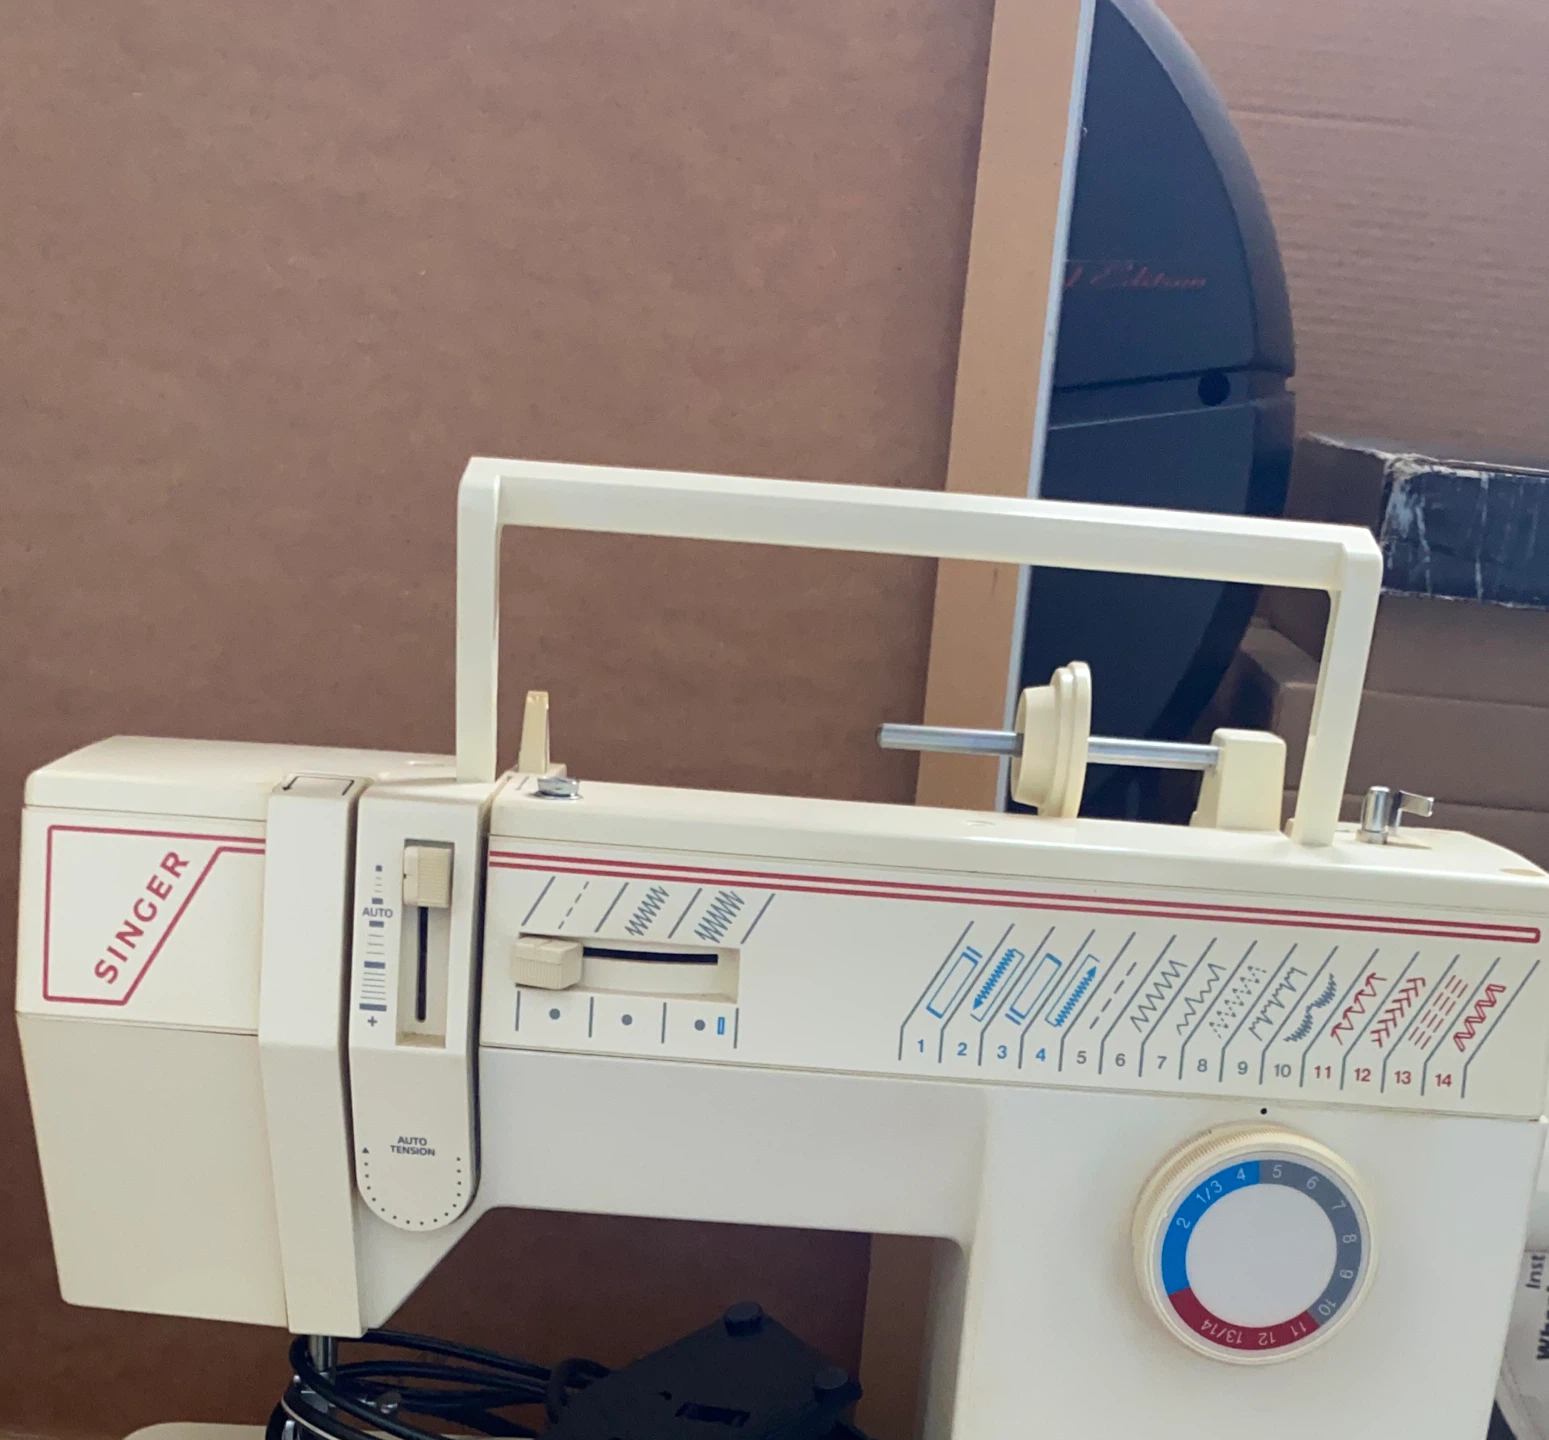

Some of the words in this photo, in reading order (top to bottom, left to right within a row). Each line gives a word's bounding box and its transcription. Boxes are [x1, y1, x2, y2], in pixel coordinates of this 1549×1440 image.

[94, 850, 190, 985] SINGER
[362, 907, 393, 919] AUTO
[917, 1039, 925, 1053] 1
[957, 1042, 968, 1056] 2
[996, 1045, 1008, 1059] 3
[1035, 1048, 1046, 1061] 4
[1076, 1050, 1087, 1064] 5
[1115, 1053, 1126, 1067] 6
[1157, 1056, 1167, 1069] 7
[1197, 1059, 1208, 1072] 8
[1237, 1061, 1248, 1075] 9
[1274, 1063, 1292, 1078] 10
[1314, 1066, 1332, 1079] 11
[1354, 1068, 1371, 1083] 12
[1394, 1071, 1412, 1085] 13
[1434, 1074, 1452, 1087] 14
[397, 1136, 428, 1146] AUTO
[390, 1145, 436, 1156] TENSION
[1236, 1167, 1247, 1181] 4
[1272, 1164, 1283, 1179] 5
[1306, 1175, 1320, 1190] 6
[1196, 1180, 1223, 1204] 1/3
[1331, 1200, 1347, 1212] 7
[1176, 1217, 1191, 1229] 2
[1342, 1233, 1357, 1244] 8
[1339, 1269, 1354, 1280] 9
[1318, 1298, 1337, 1317] 10
[1200, 1317, 1243, 1345] 13/14
[1290, 1321, 1308, 1338] 11
[1258, 1331, 1277, 1346] 12
